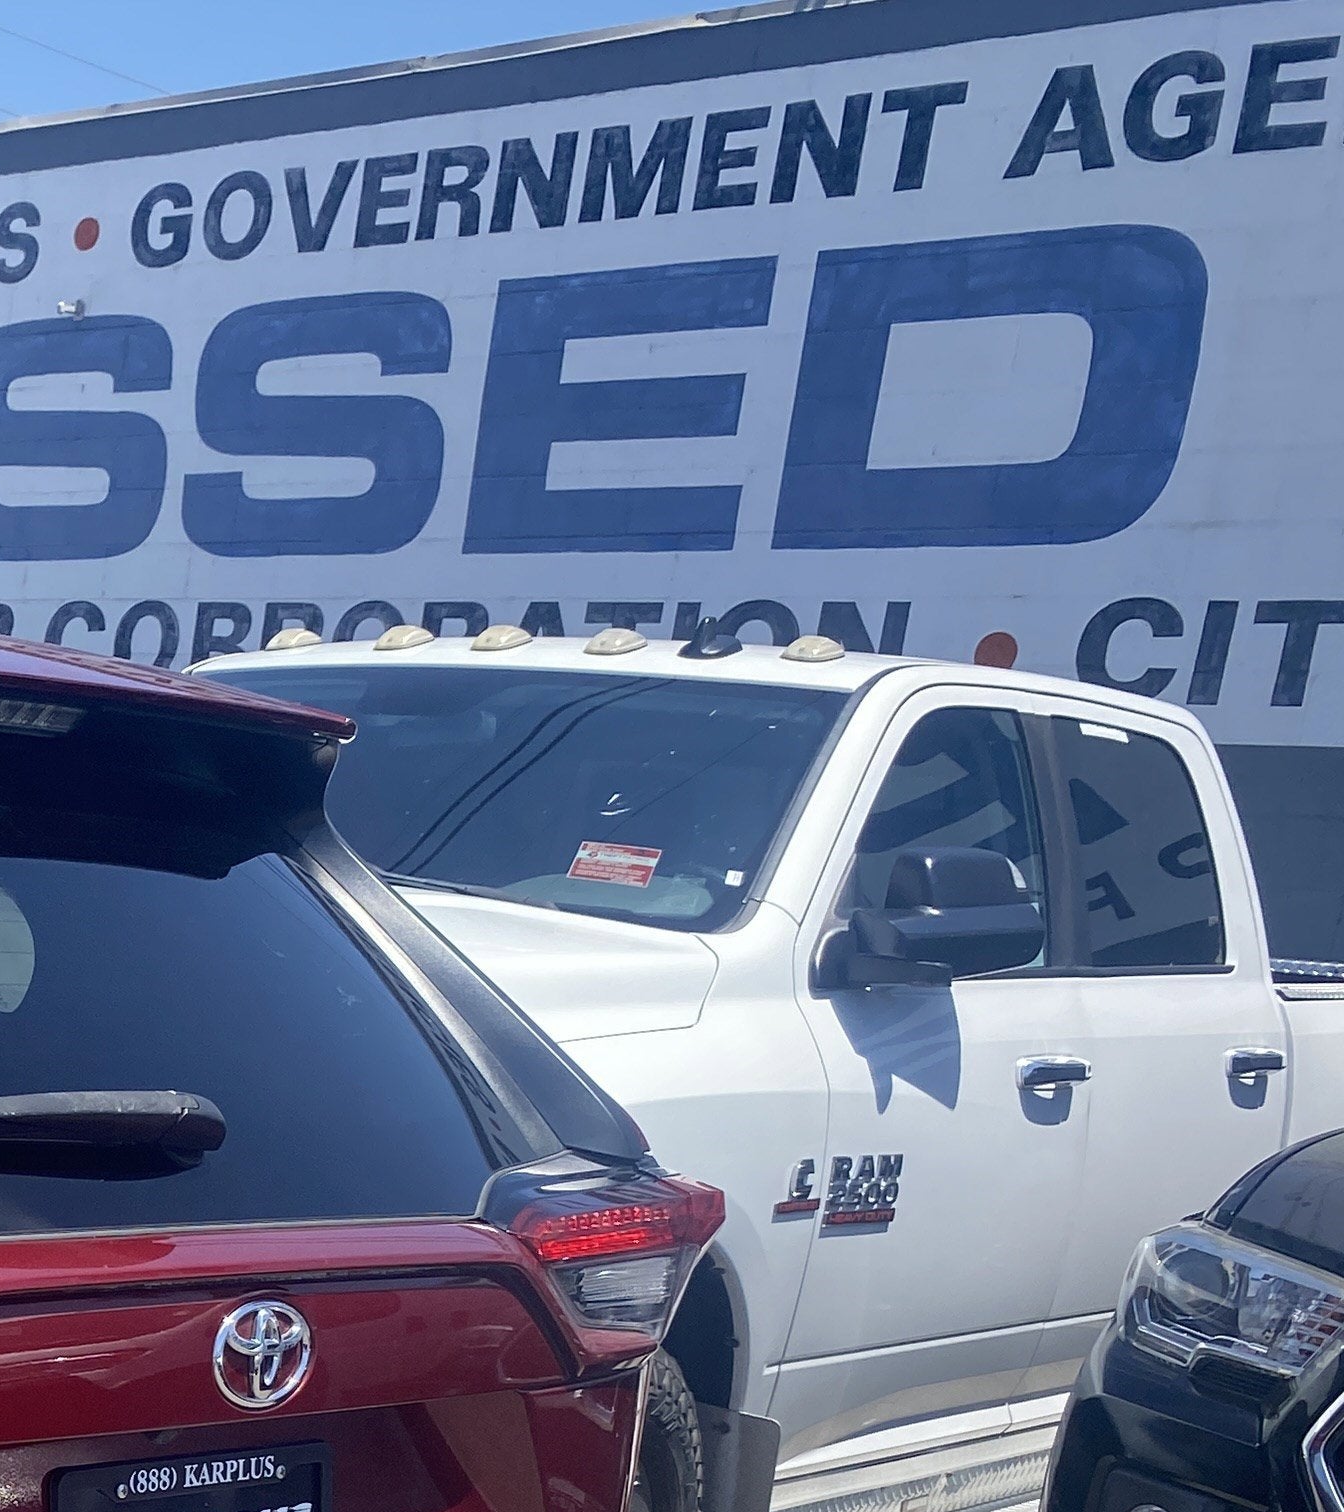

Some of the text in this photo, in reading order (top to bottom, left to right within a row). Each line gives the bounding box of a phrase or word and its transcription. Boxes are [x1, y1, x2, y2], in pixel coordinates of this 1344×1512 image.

[130, 81, 969, 268] GOVERNMENT
[1002, 35, 1344, 179] AGE
[830, 1153, 904, 1180] RAM
[129, 1455, 276, 1495] (888) KARPLUS
